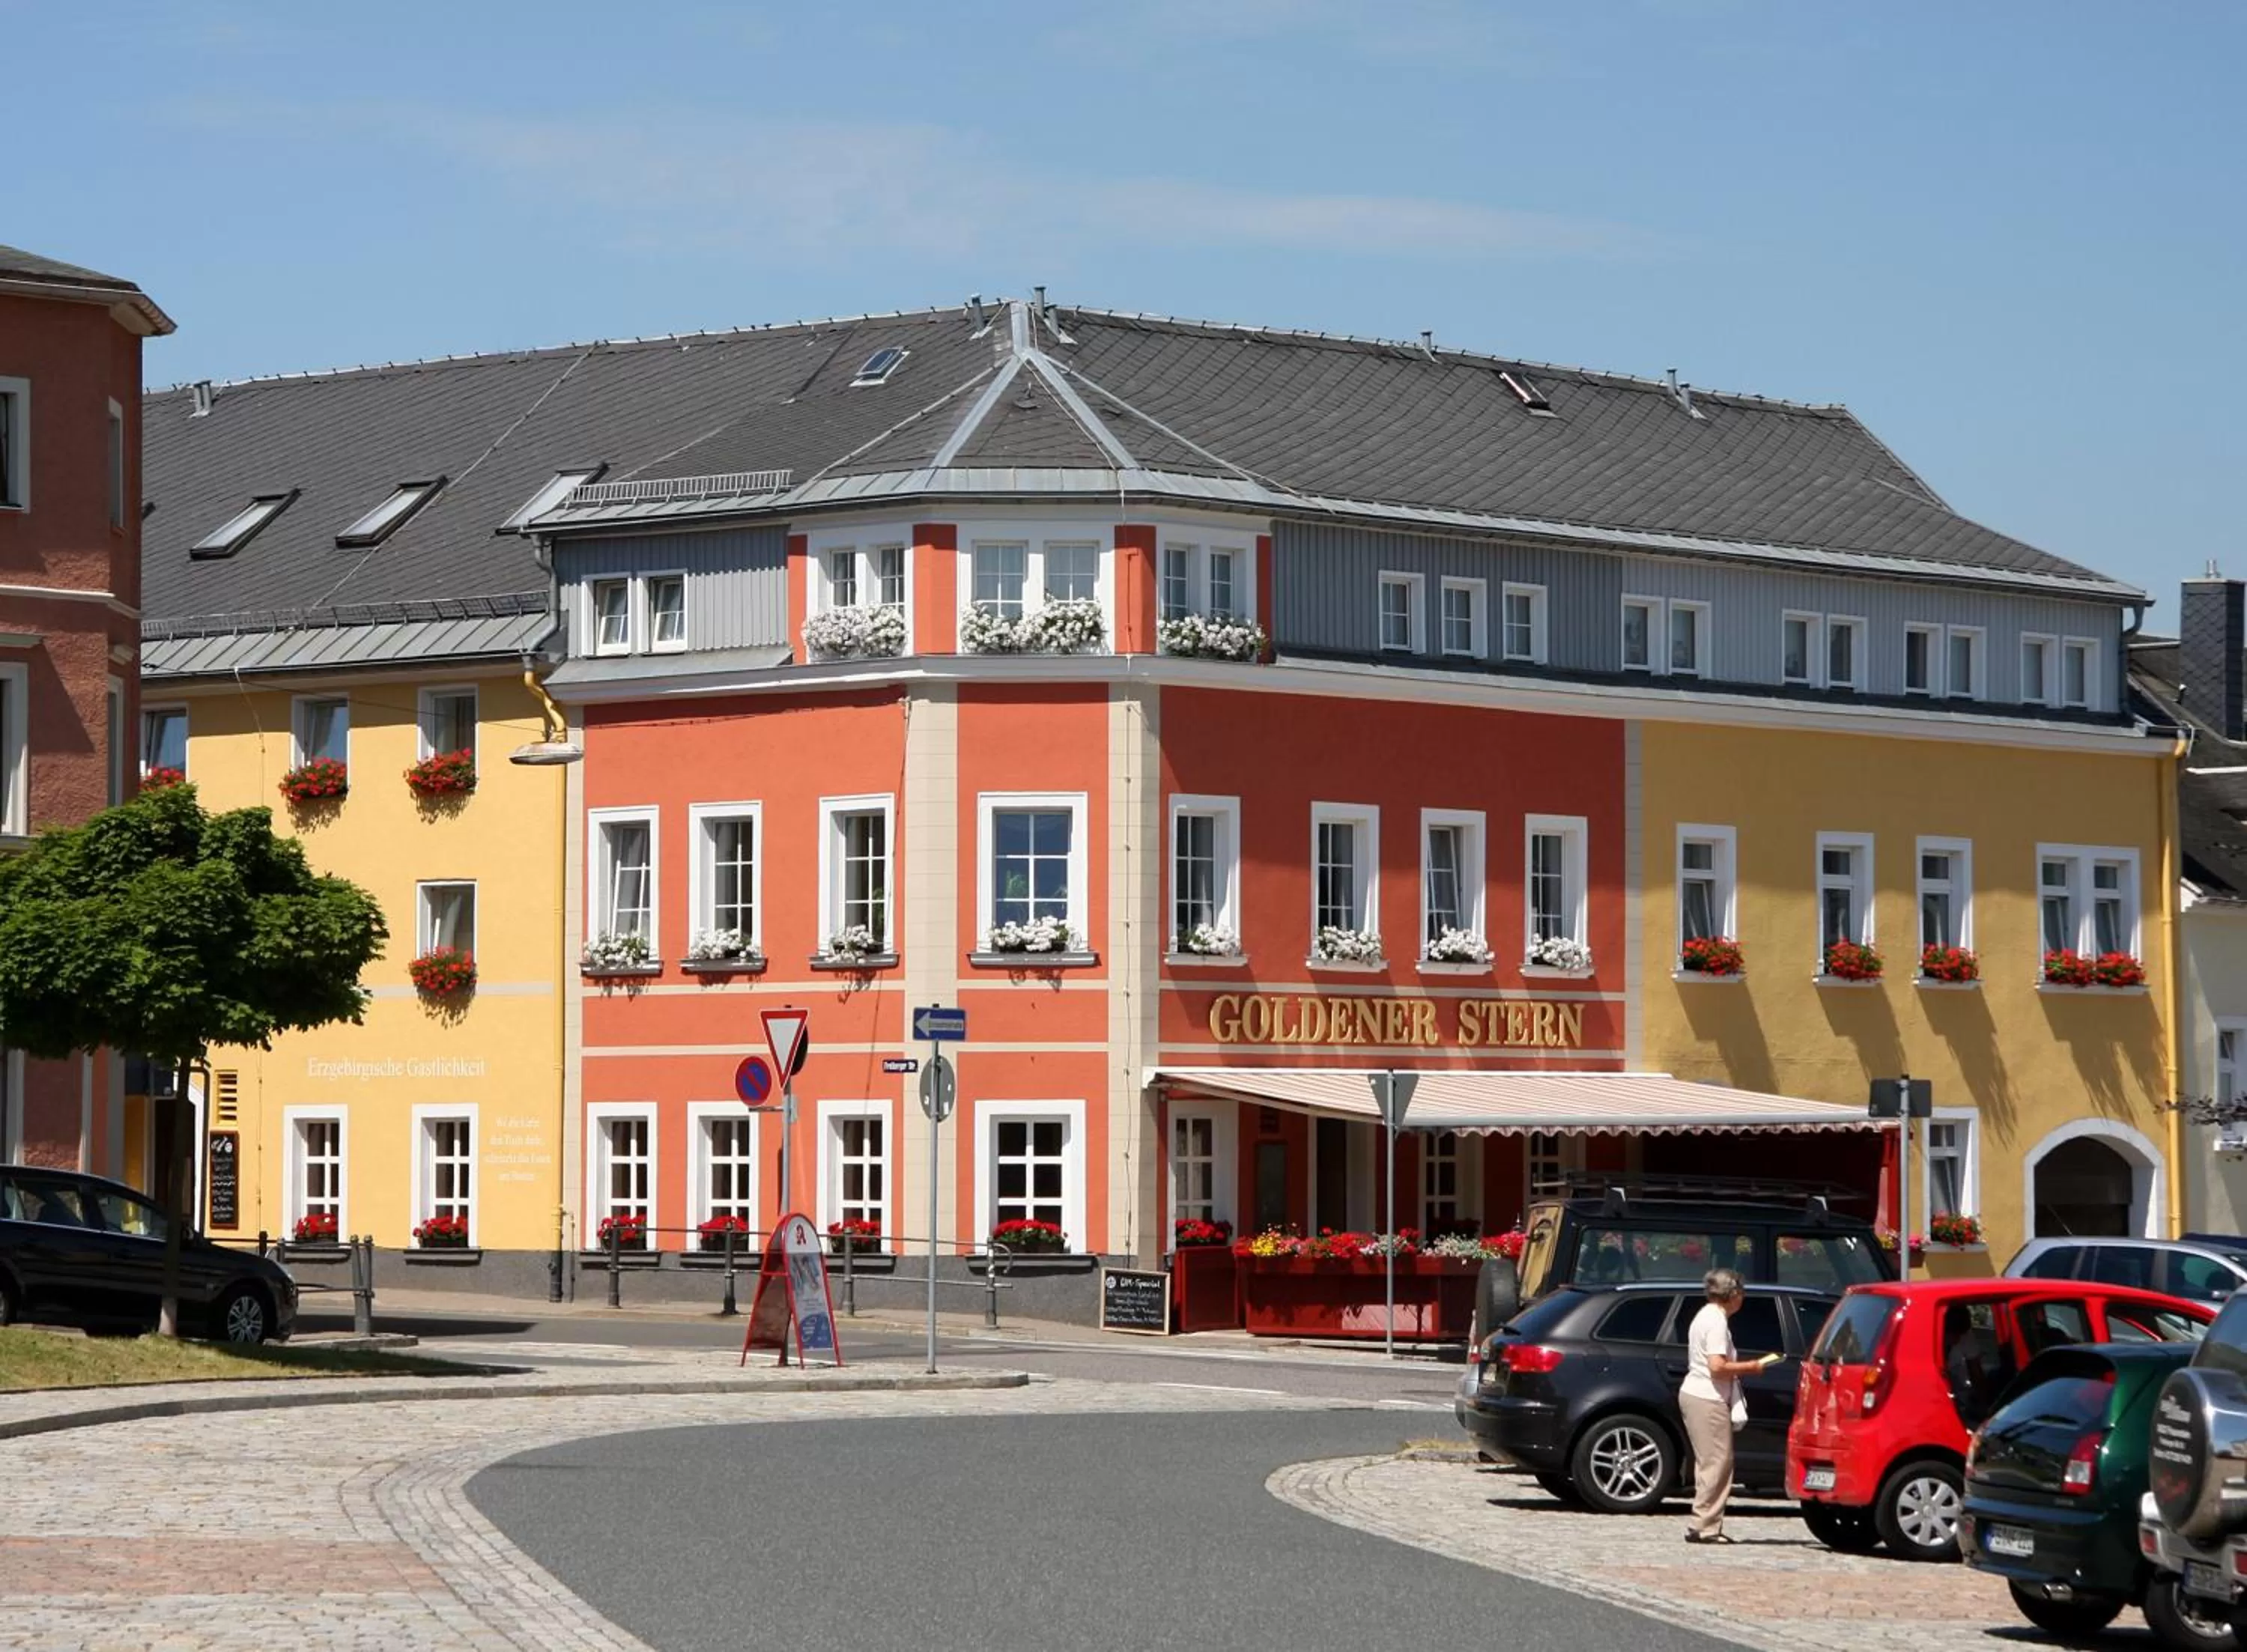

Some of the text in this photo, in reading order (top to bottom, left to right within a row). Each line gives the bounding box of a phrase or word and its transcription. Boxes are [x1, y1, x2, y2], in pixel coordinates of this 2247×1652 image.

[1209, 994, 1585, 1048] GOLDENER STERN
[307, 1057, 485, 1081] Erzgebirgische Gastlichkeit
